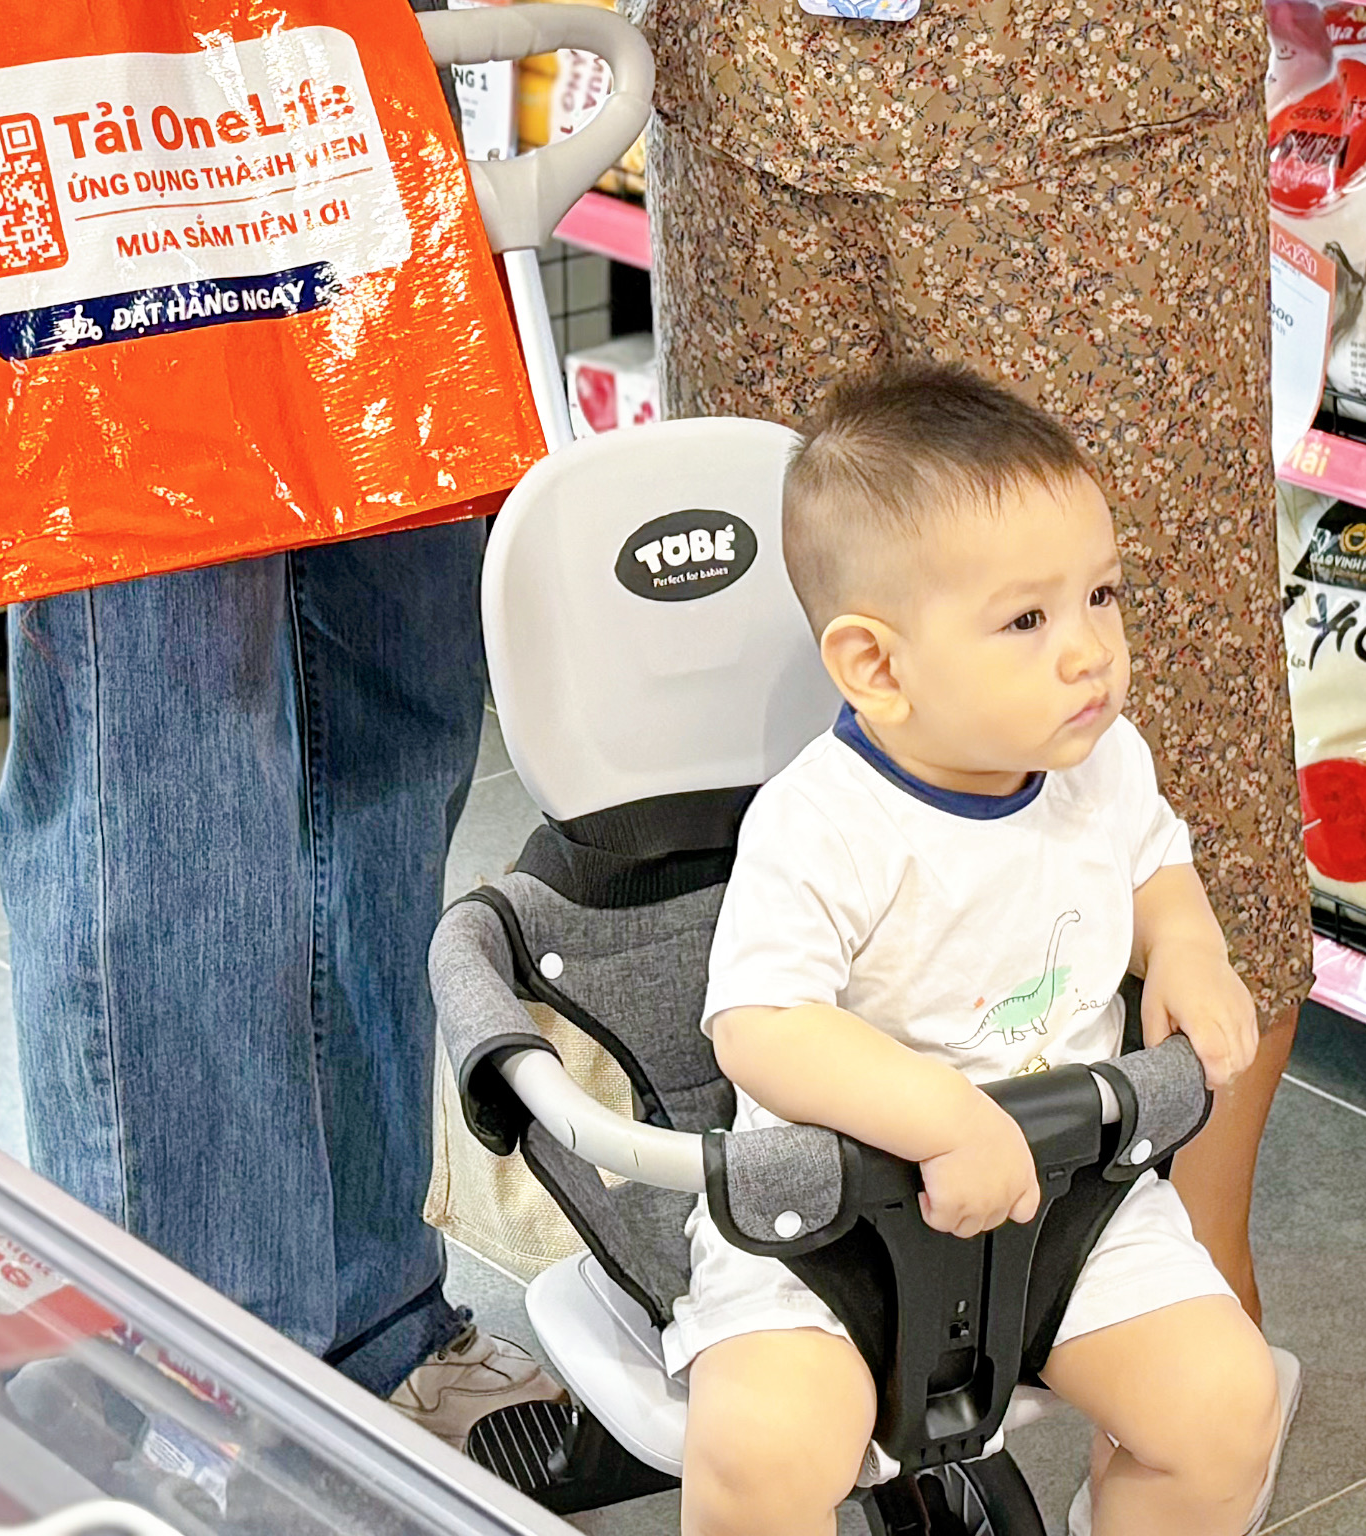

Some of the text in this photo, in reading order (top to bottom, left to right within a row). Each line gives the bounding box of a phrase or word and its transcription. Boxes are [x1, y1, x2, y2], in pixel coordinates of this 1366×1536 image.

[53, 79, 356, 160] Tải OneLife
[67, 171, 130, 204] ỨNG
[136, 167, 199, 199] DỤNG
[200, 151, 296, 189] THÀNH
[115, 228, 182, 259] MUA
[111, 279, 306, 333] ĐẶT HÀNG NGAY
[653, 567, 729, 588] Perfect for babies
[1334, 555, 1360, 569] VINH
